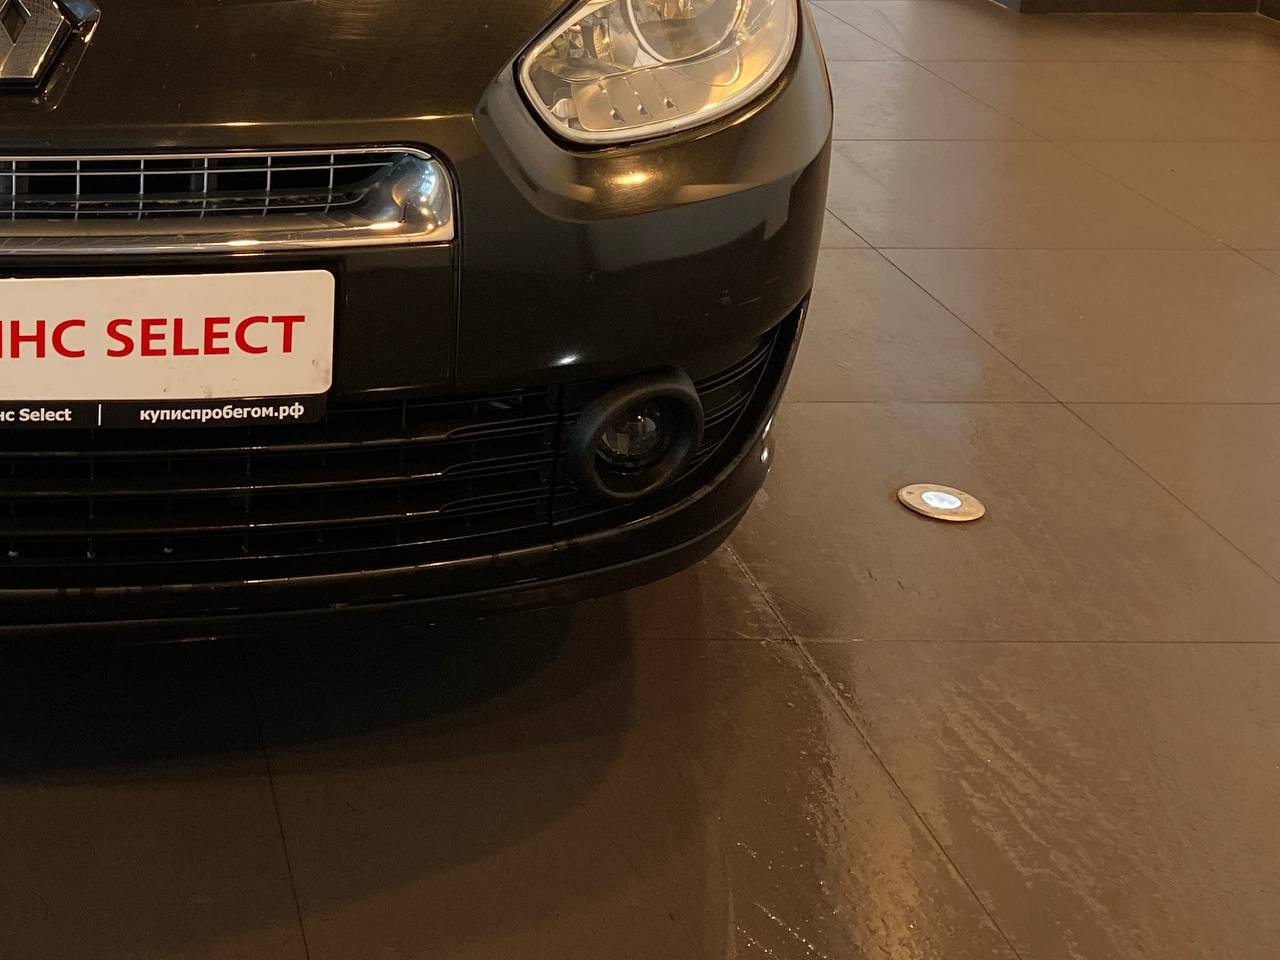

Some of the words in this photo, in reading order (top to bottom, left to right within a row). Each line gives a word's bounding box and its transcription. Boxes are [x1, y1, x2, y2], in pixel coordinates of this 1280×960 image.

[106, 314, 305, 358] SELECT
[18, 407, 72, 422] Select
[139, 401, 305, 424] куписпробегом.рф
